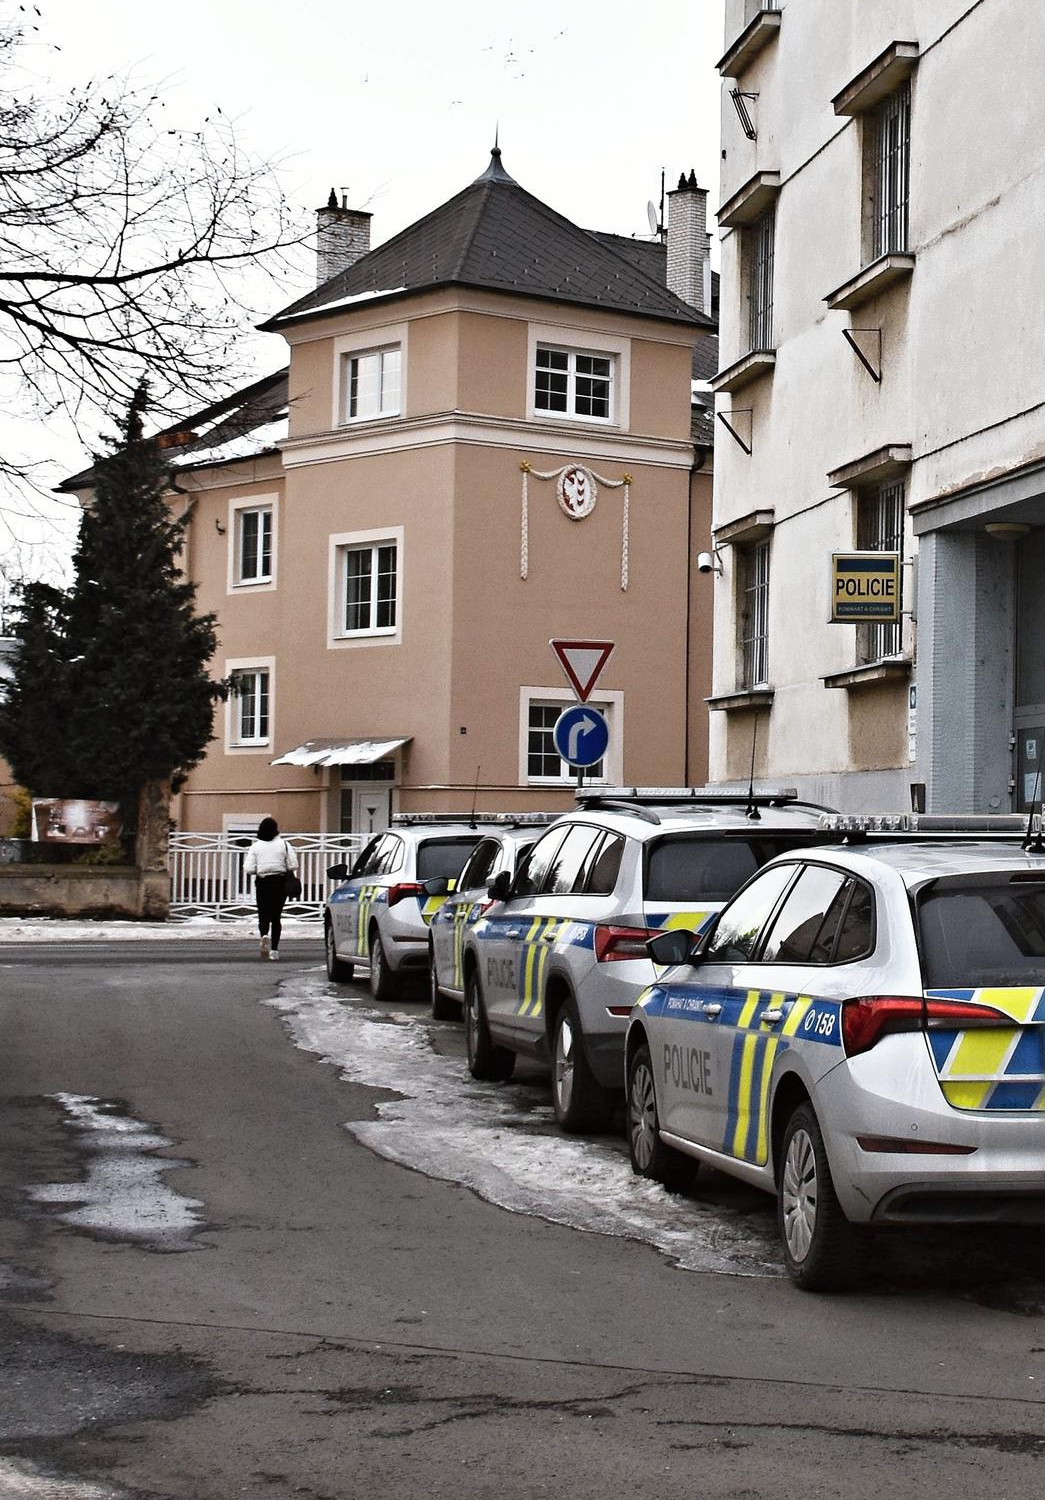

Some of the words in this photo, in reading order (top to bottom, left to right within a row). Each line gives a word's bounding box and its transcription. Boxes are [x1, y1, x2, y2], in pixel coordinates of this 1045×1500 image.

[836, 578, 895, 596] POLICIE
[814, 1011, 836, 1036] 158
[663, 1043, 713, 1096] POLICIE
